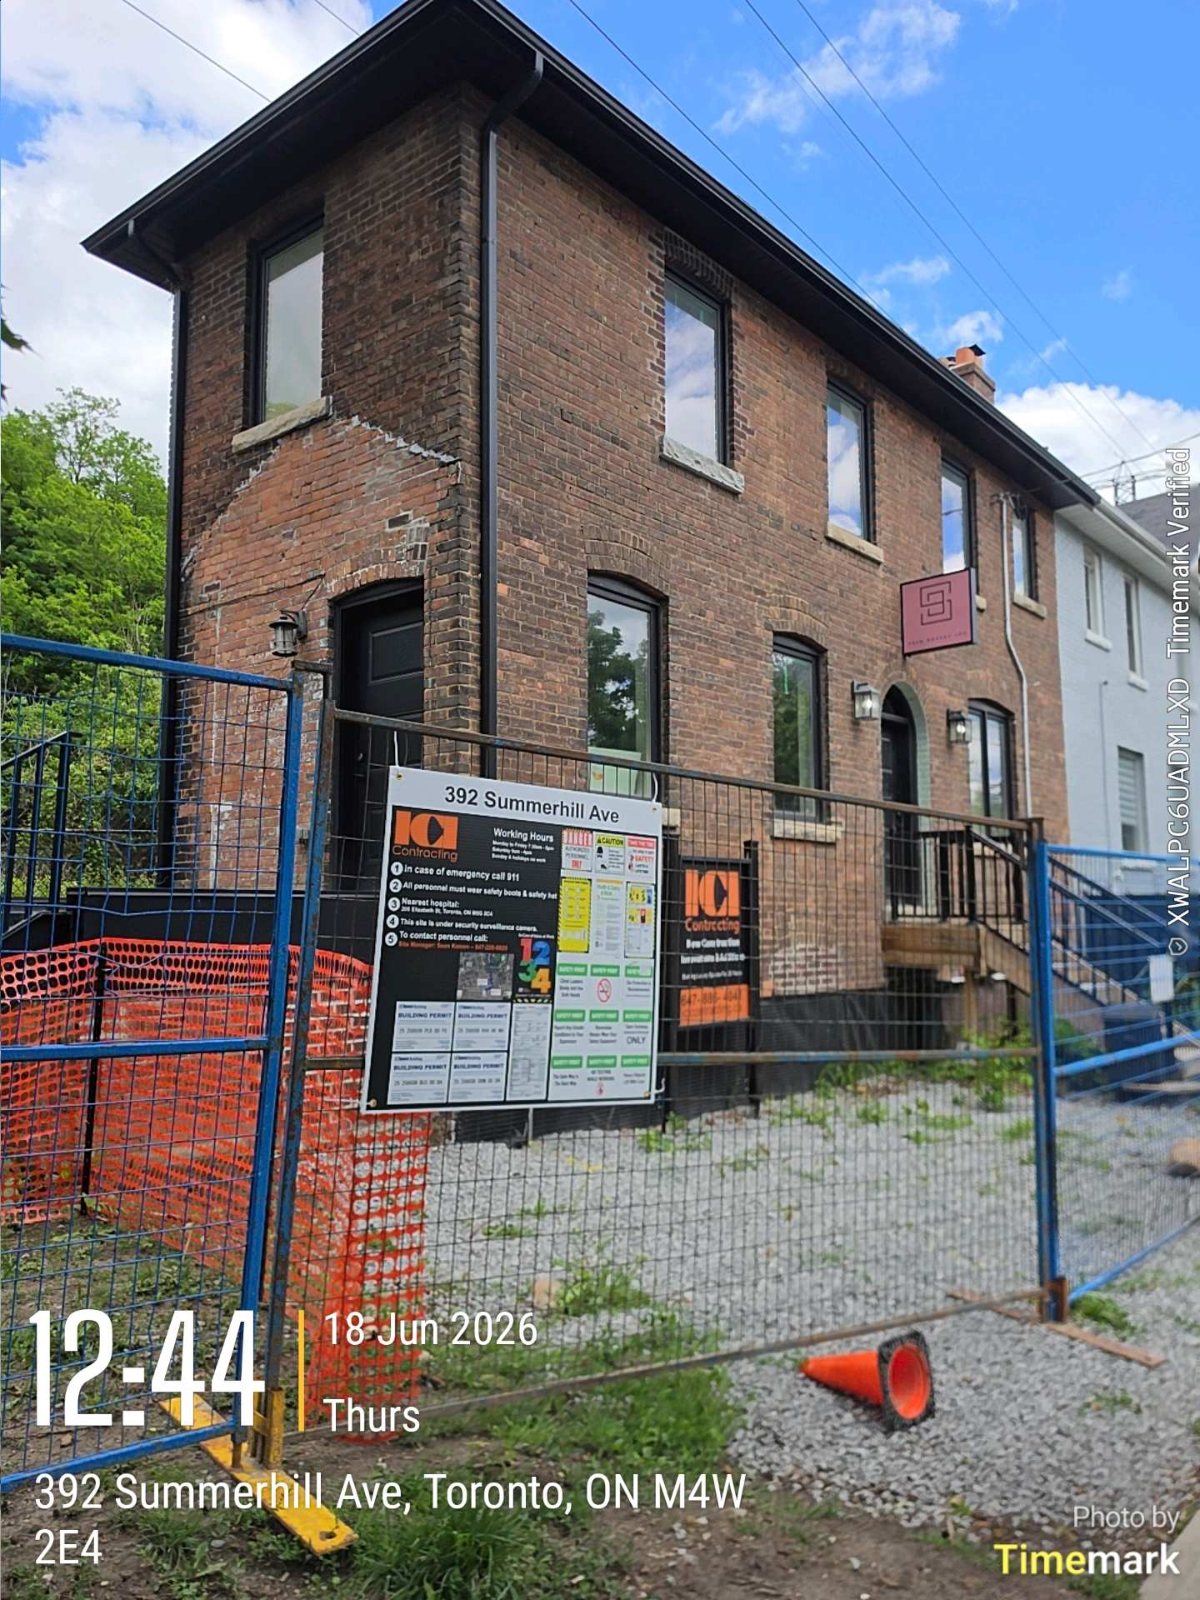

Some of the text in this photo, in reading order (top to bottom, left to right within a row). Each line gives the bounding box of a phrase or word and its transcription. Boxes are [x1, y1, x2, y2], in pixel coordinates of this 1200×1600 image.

[445, 786, 619, 823] 392 Summerhill Ave
[493, 827, 554, 842] Working Hours
[601, 837, 624, 846] CAUTION
[392, 846, 458, 863] Contracting
[404, 864, 413, 873] In
[414, 866, 434, 875] case
[435, 867, 445, 875] of
[446, 869, 490, 881] emergency
[491, 872, 506, 880] call
[507, 872, 520, 882] 911
[414, 884, 448, 892] personnel
[483, 887, 503, 897] safety
[503, 888, 522, 897] boots
[528, 891, 547, 900] safety
[401, 898, 429, 906] Nearest
[430, 899, 460, 909] hospital:
[455, 922, 479, 931] security
[480, 923, 515, 931] surveillance
[400, 930, 409, 938] To
[409, 932, 437, 940] contact
[438, 934, 473, 942] personnel
[520, 938, 550, 966] 1 2
[531, 968, 552, 993] 4
[626, 1035, 646, 1045] ONLY
